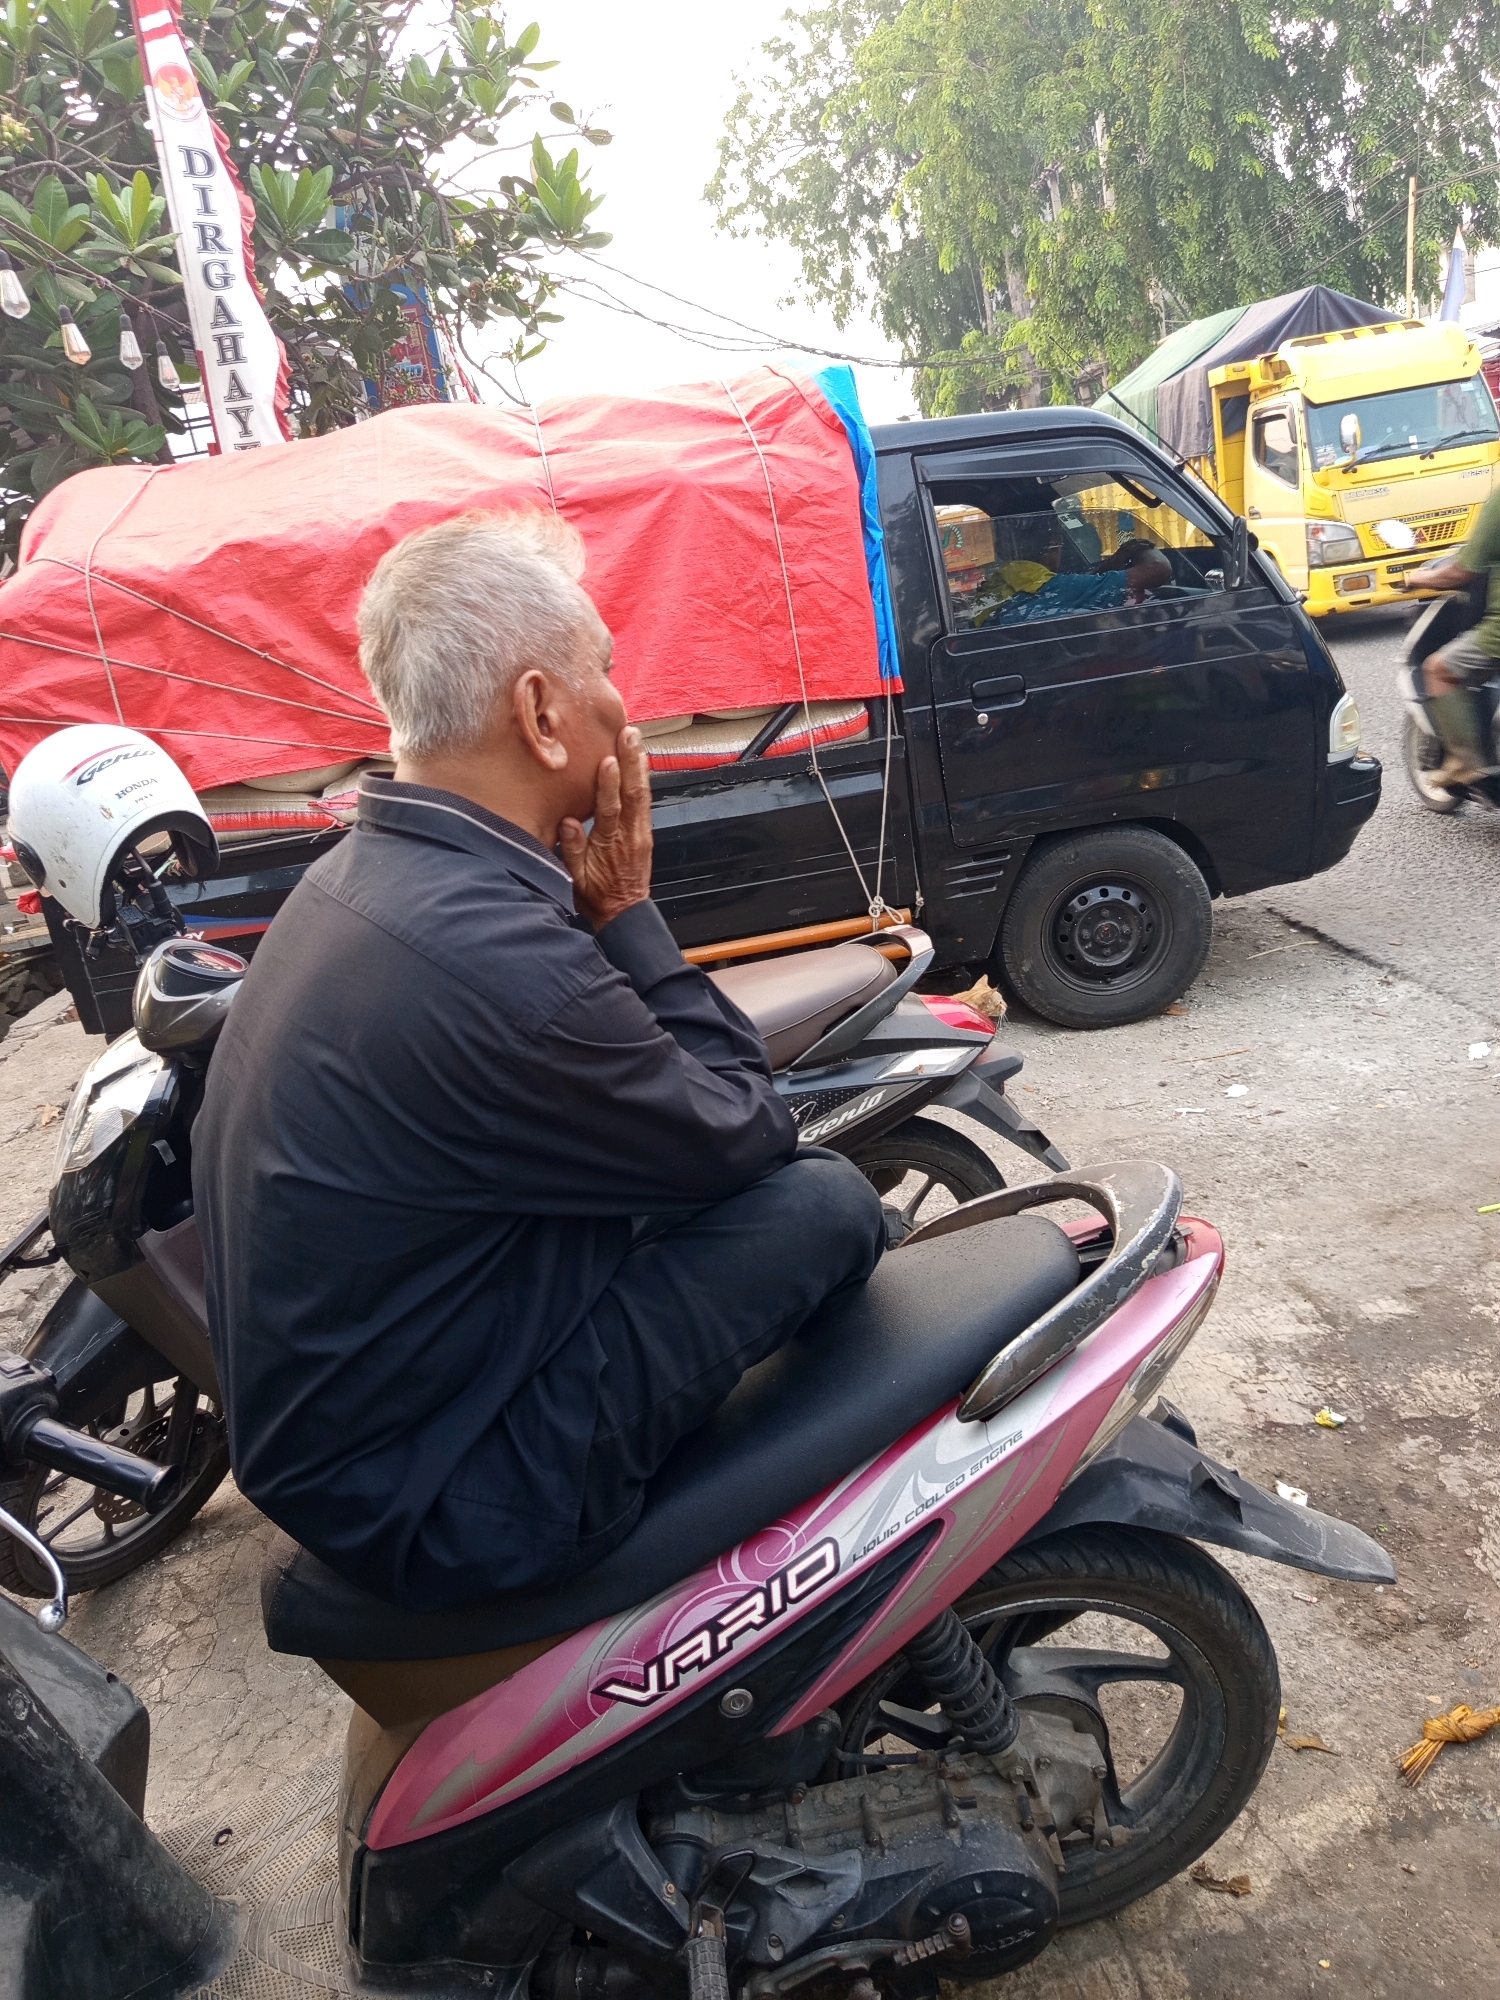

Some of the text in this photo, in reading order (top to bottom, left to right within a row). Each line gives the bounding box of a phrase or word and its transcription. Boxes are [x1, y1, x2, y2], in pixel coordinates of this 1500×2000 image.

[177, 144, 262, 450] DIRGAHAY
[114, 778, 159, 800] HONDA
[797, 1088, 887, 1142] Genio
[852, 1429, 1024, 1564] LIQUID COOLED ENGINE
[596, 1539, 840, 1705] VARIO
